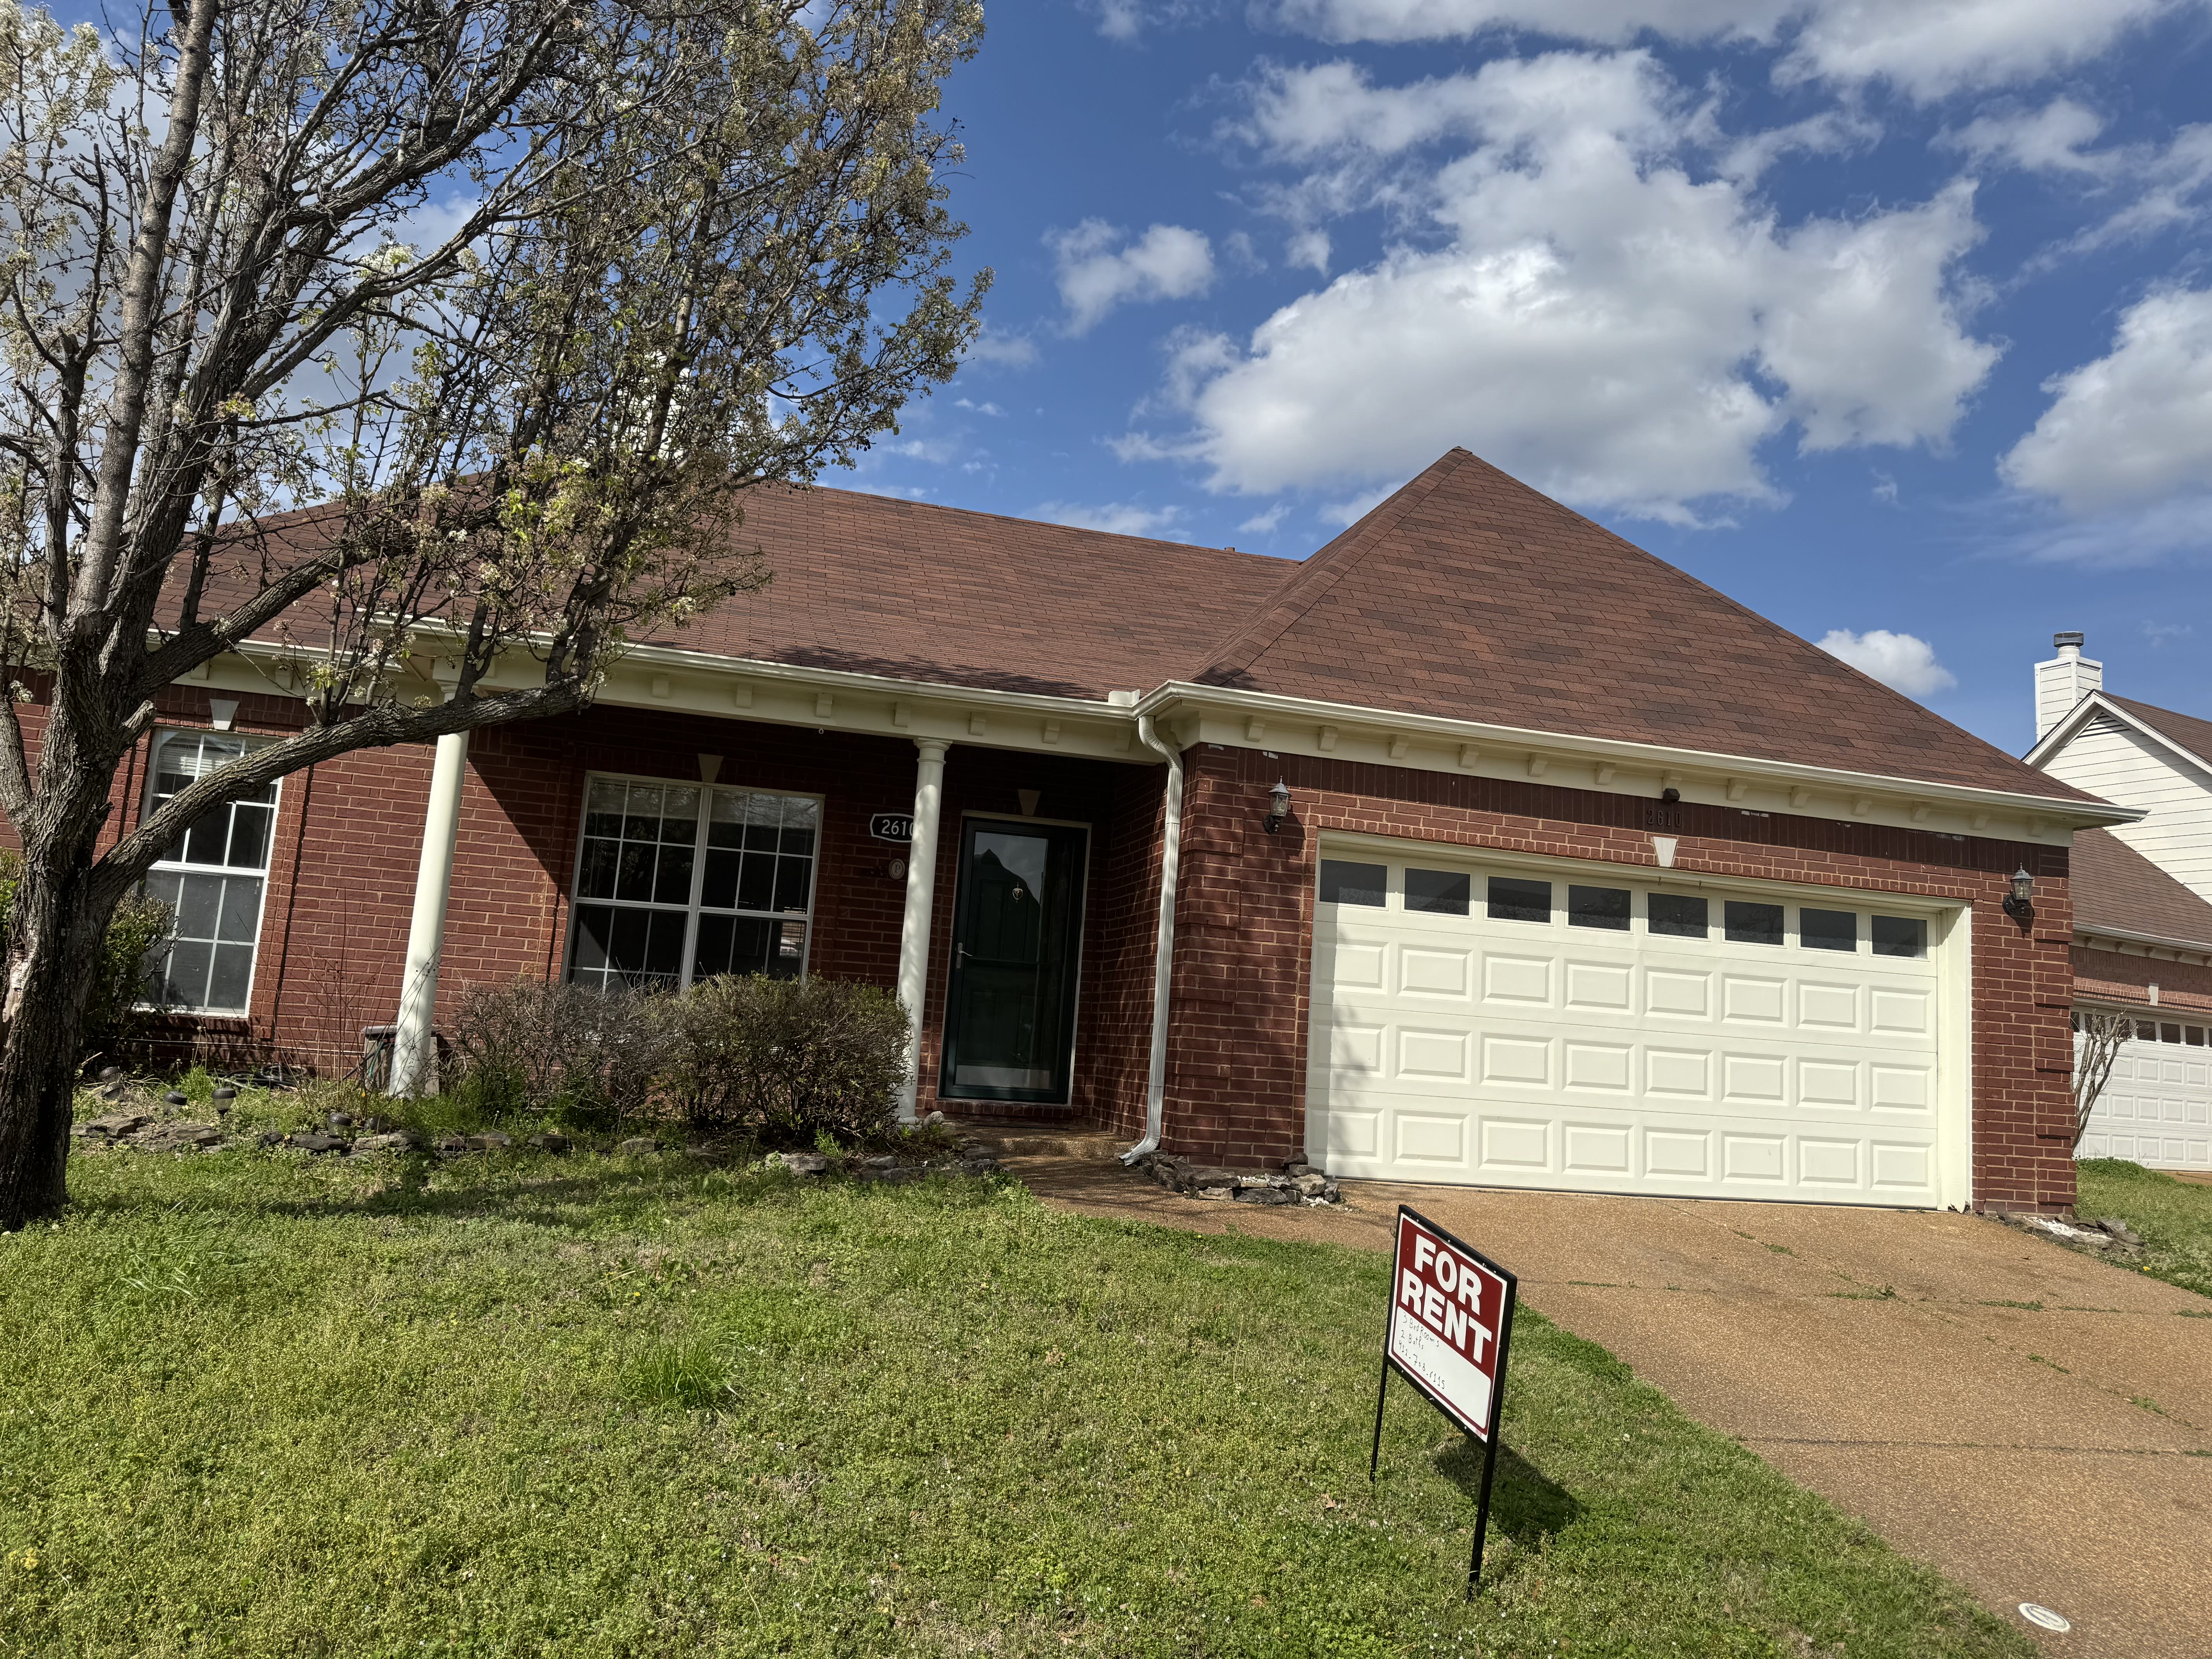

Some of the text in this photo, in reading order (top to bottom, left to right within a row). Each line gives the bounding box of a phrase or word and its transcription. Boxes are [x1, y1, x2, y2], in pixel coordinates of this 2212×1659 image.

[1648, 809, 1681, 826] 2610
[895, 864, 900, 873] P
[1415, 1234, 1482, 1316] FOR
[1401, 1267, 1492, 1364] RENT
[1403, 1312, 1407, 1323] 3
[1401, 1330, 1424, 1349] 2 Baths
